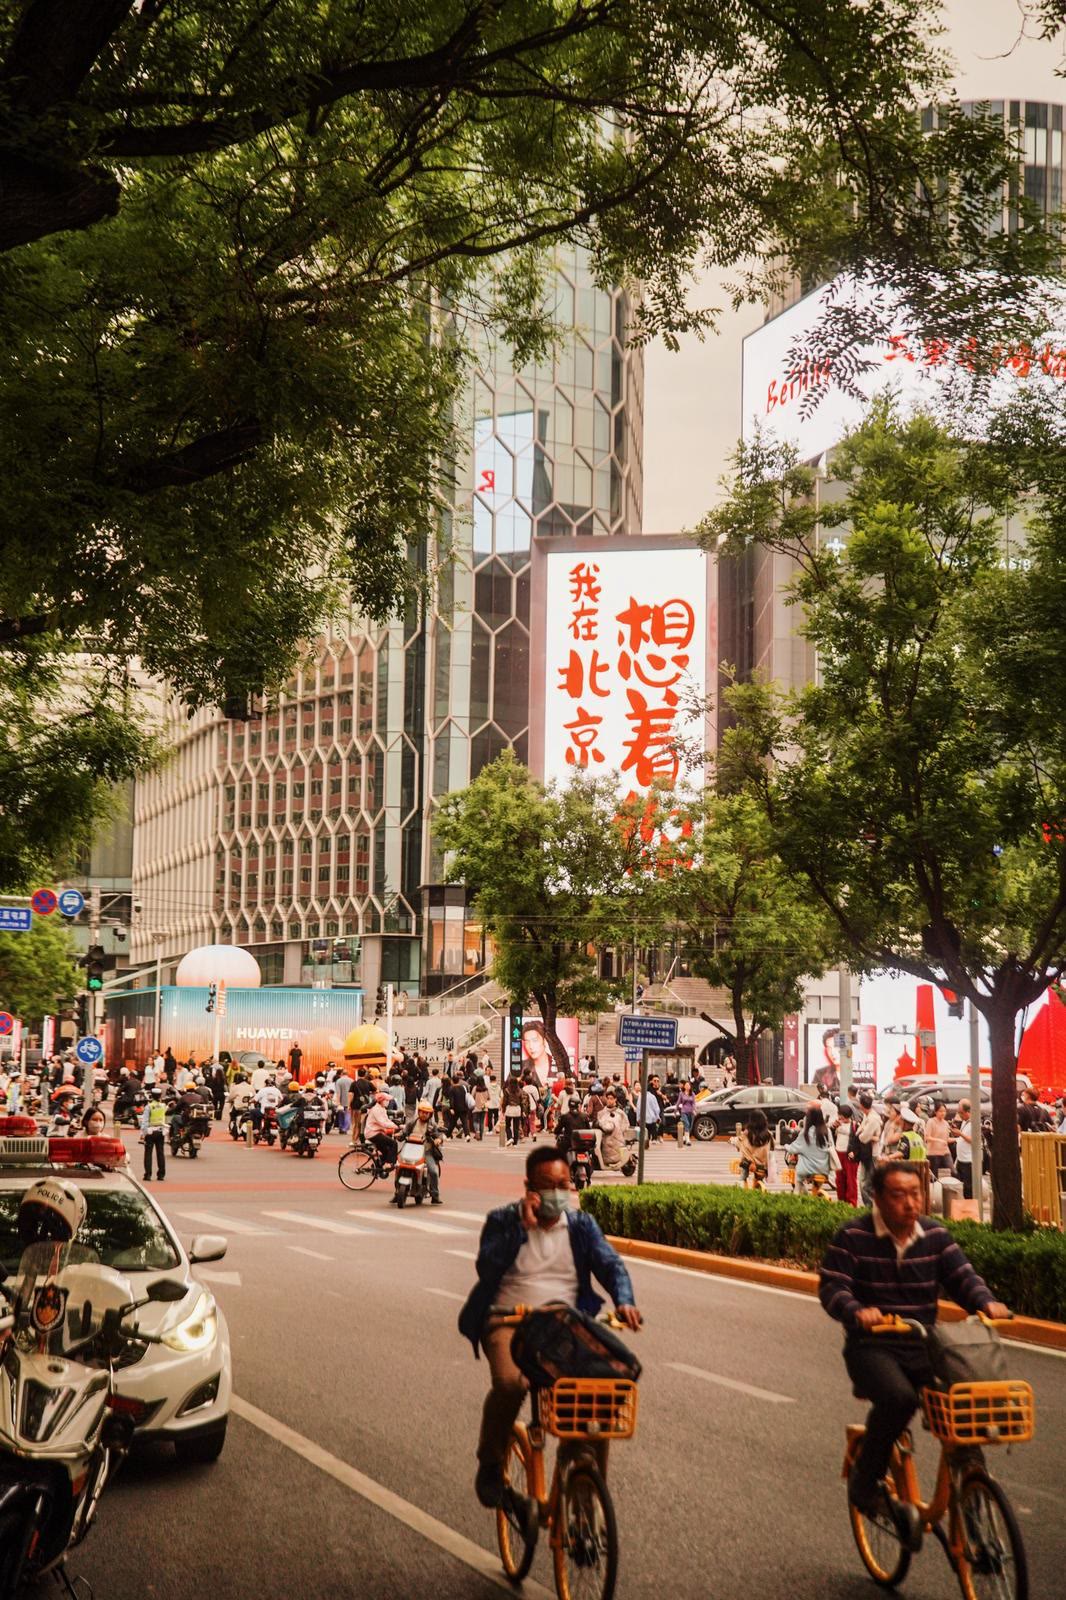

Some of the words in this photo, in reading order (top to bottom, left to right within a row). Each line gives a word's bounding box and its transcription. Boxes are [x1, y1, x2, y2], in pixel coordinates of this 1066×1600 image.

[557, 561, 611, 770] 我在北京
[237, 1026, 294, 1039] HUAWEI
[37, 1188, 64, 1205] POLICE
